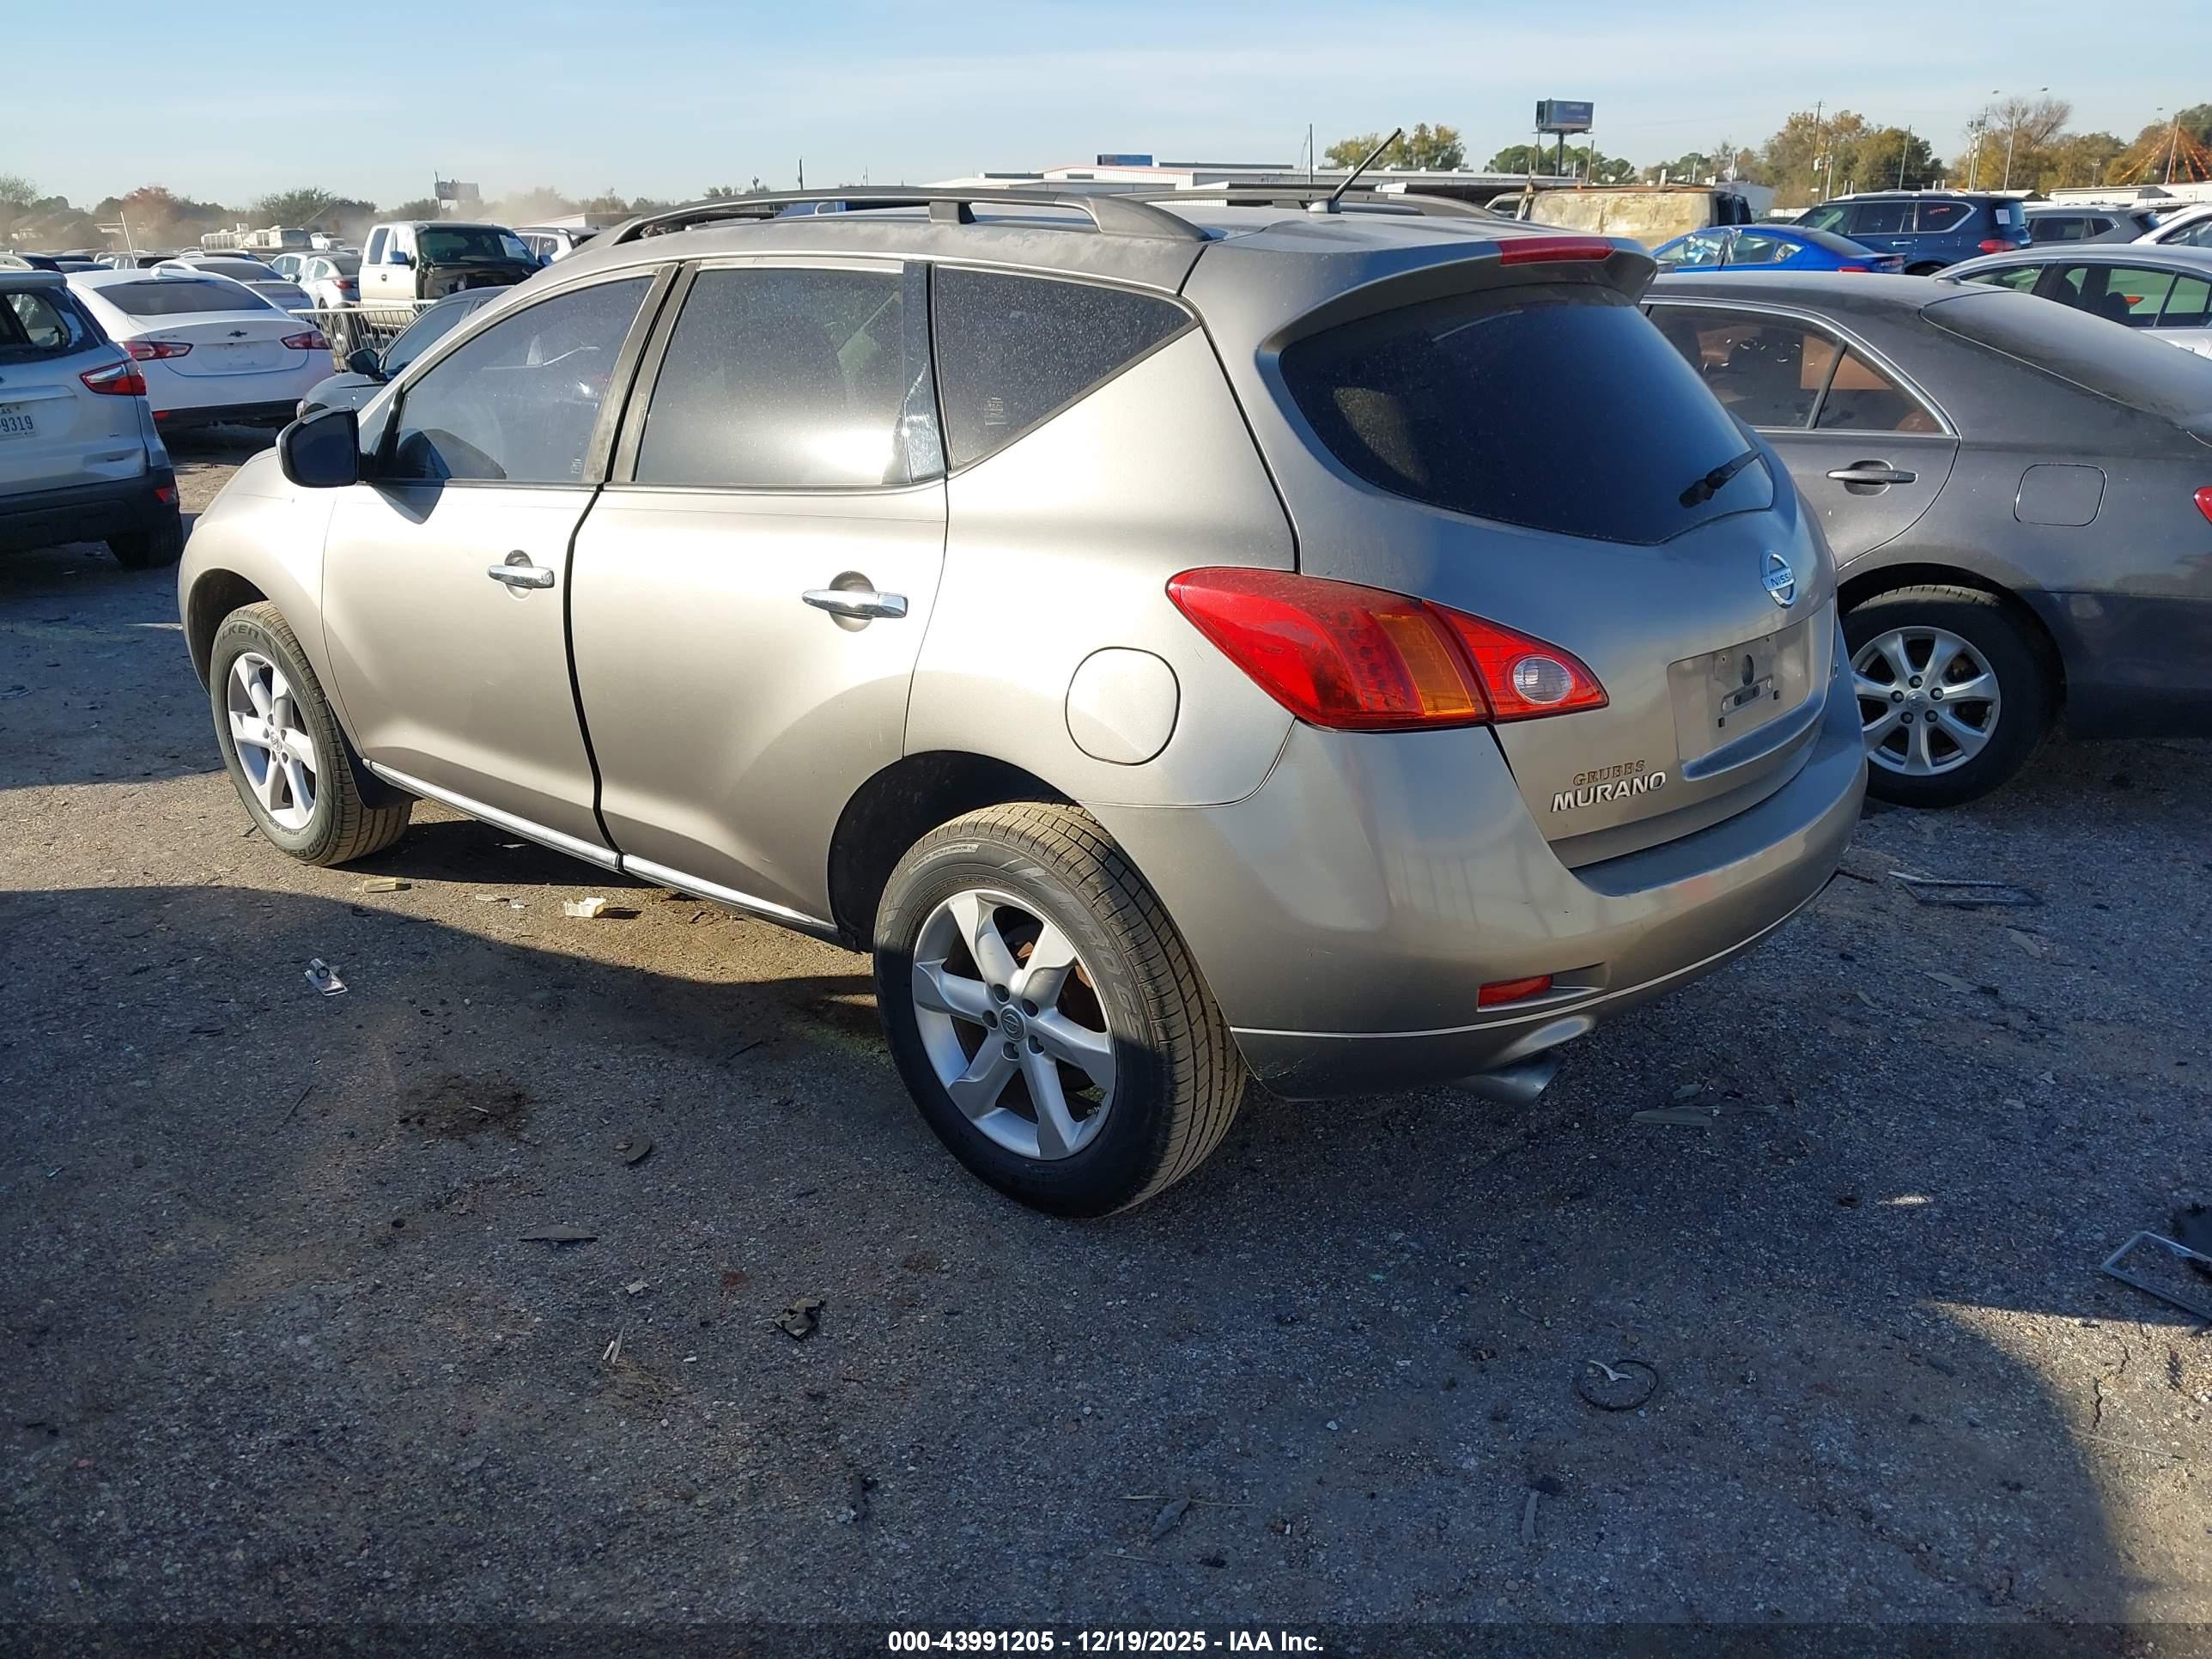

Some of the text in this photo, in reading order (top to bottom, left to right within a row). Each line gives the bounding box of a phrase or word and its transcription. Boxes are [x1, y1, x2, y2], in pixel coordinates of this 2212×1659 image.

[1, 416, 33, 433] 9319
[1573, 760, 1645, 787] GRUBBS
[1551, 771, 1667, 812] MURANO
